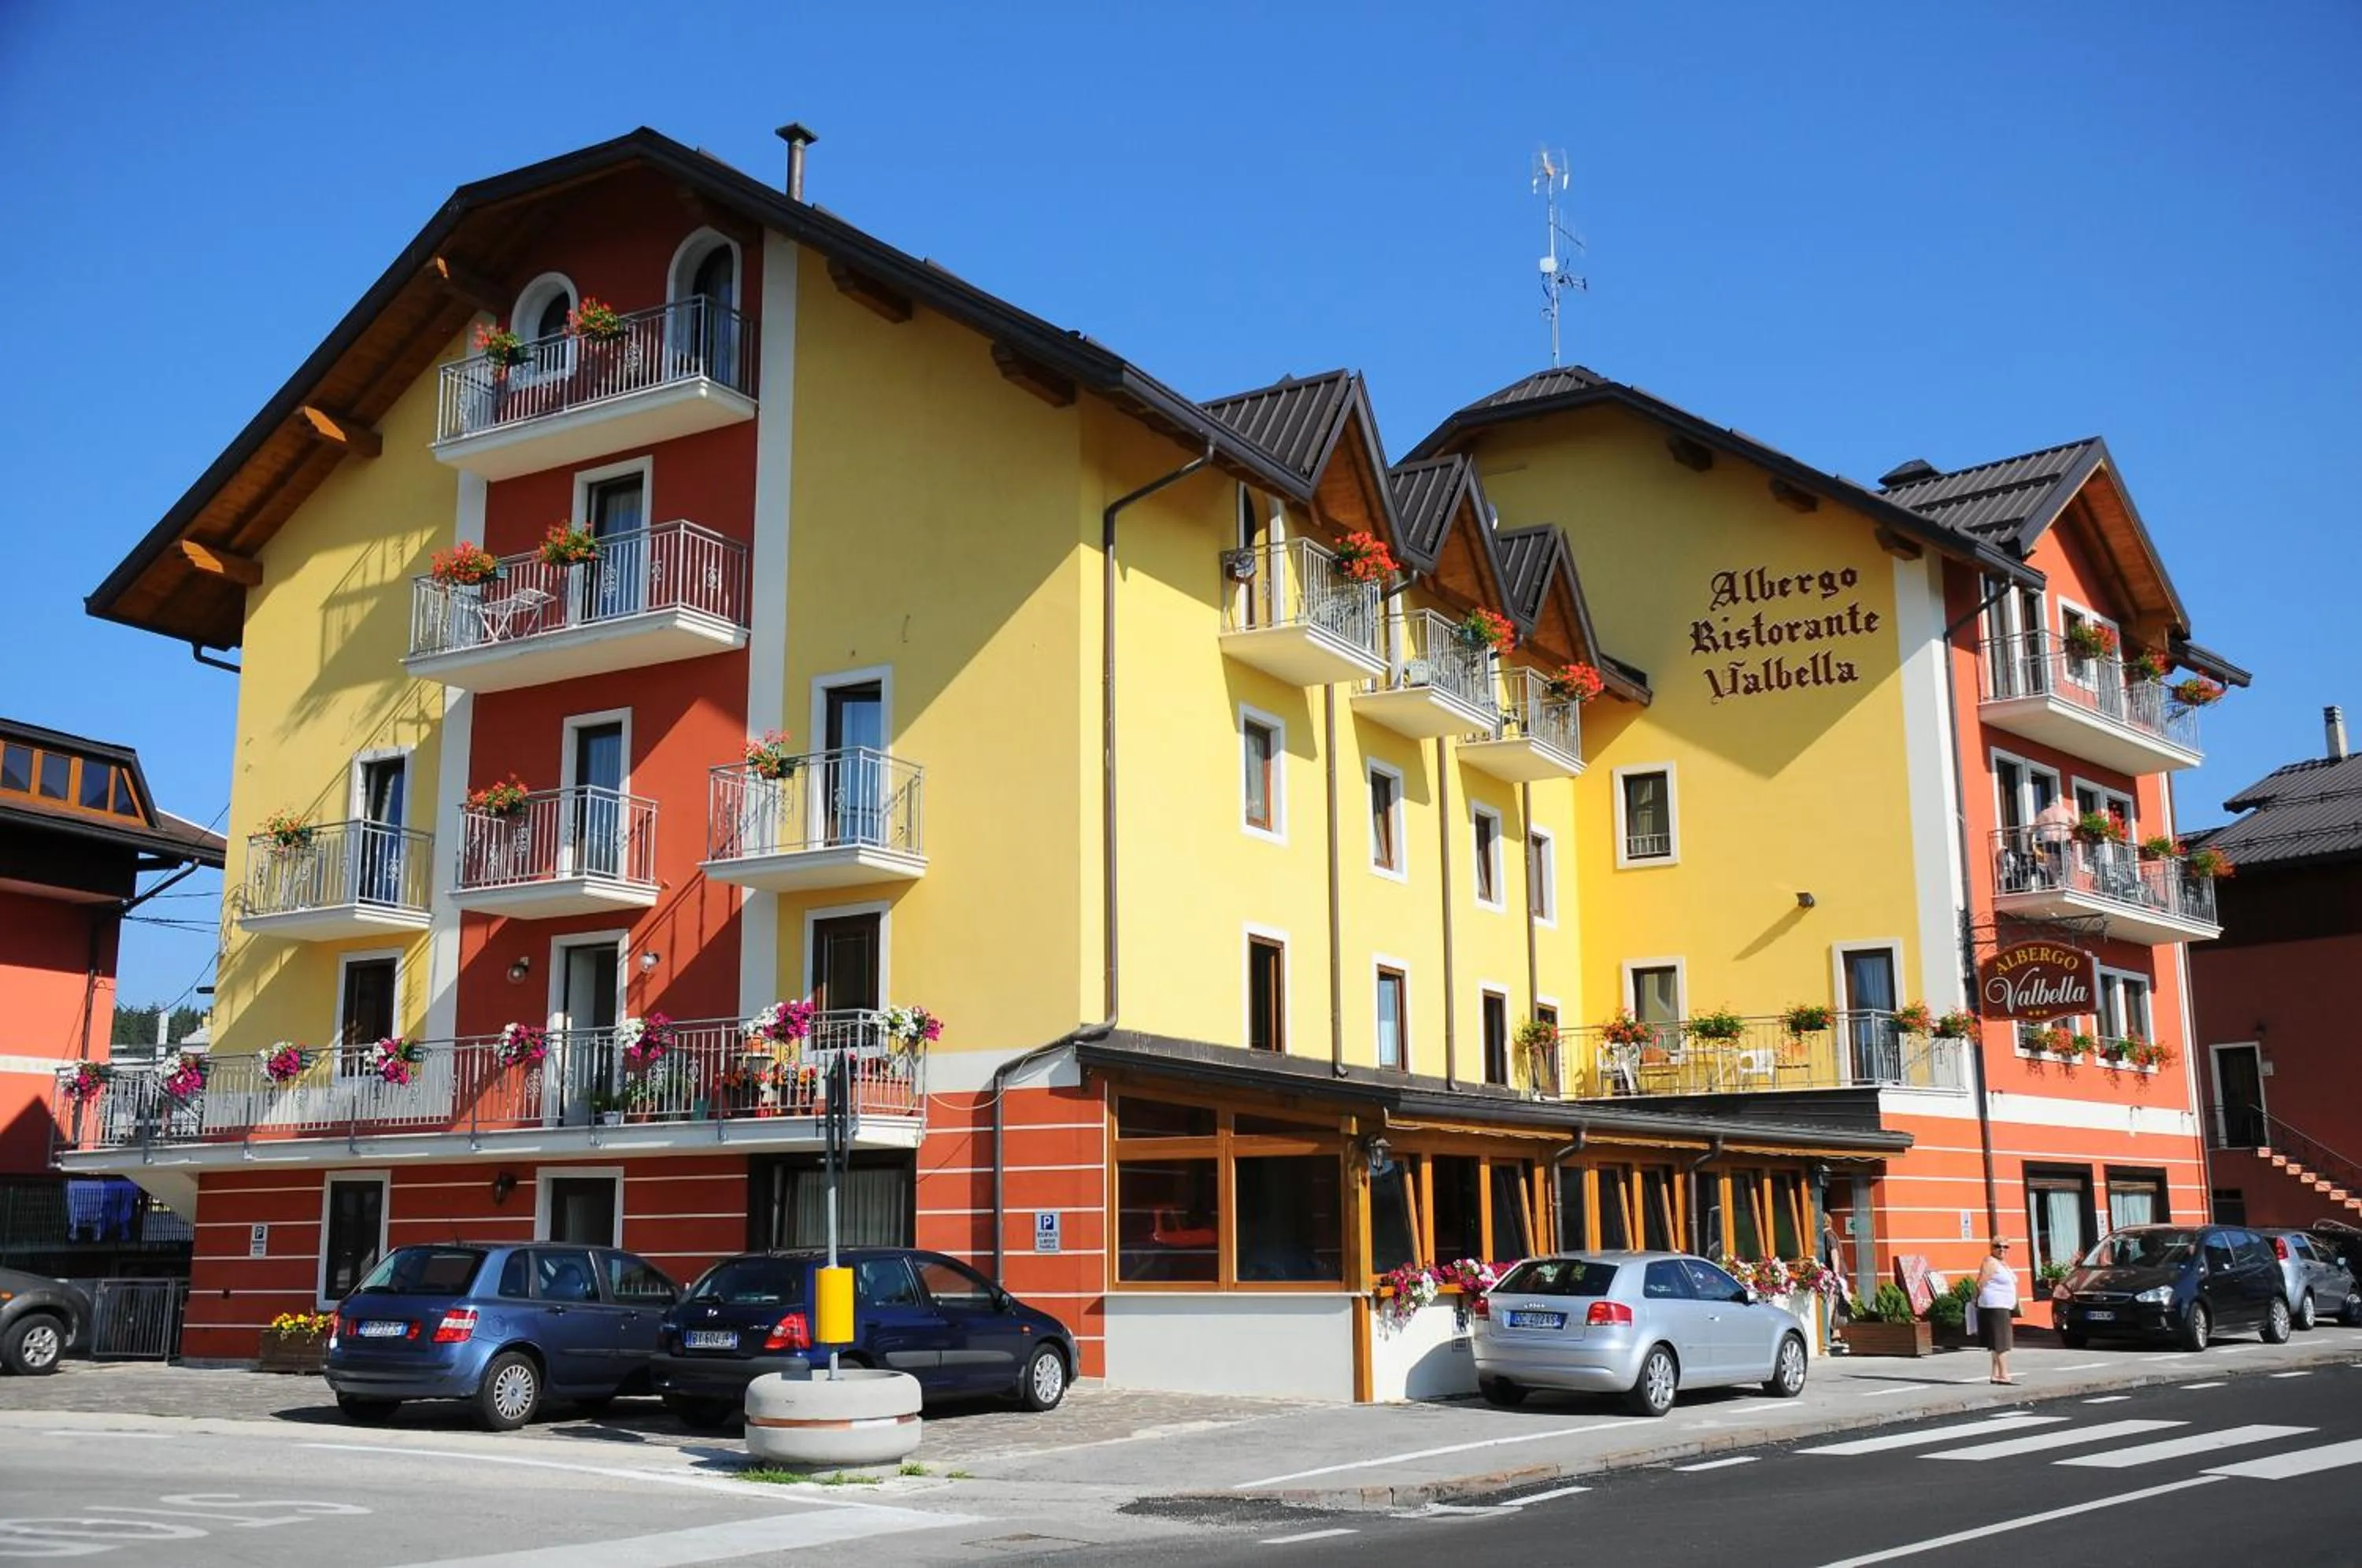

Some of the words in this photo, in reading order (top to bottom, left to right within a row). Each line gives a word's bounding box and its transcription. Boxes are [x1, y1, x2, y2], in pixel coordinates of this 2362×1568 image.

[1709, 567, 1857, 612] Albergo
[1690, 602, 1879, 655] Ristorante
[1703, 650, 1859, 704] Valbella
[1995, 947, 2079, 975] ALBERGO
[1985, 967, 2089, 1014] Valbella
[1043, 1216, 1052, 1229] P
